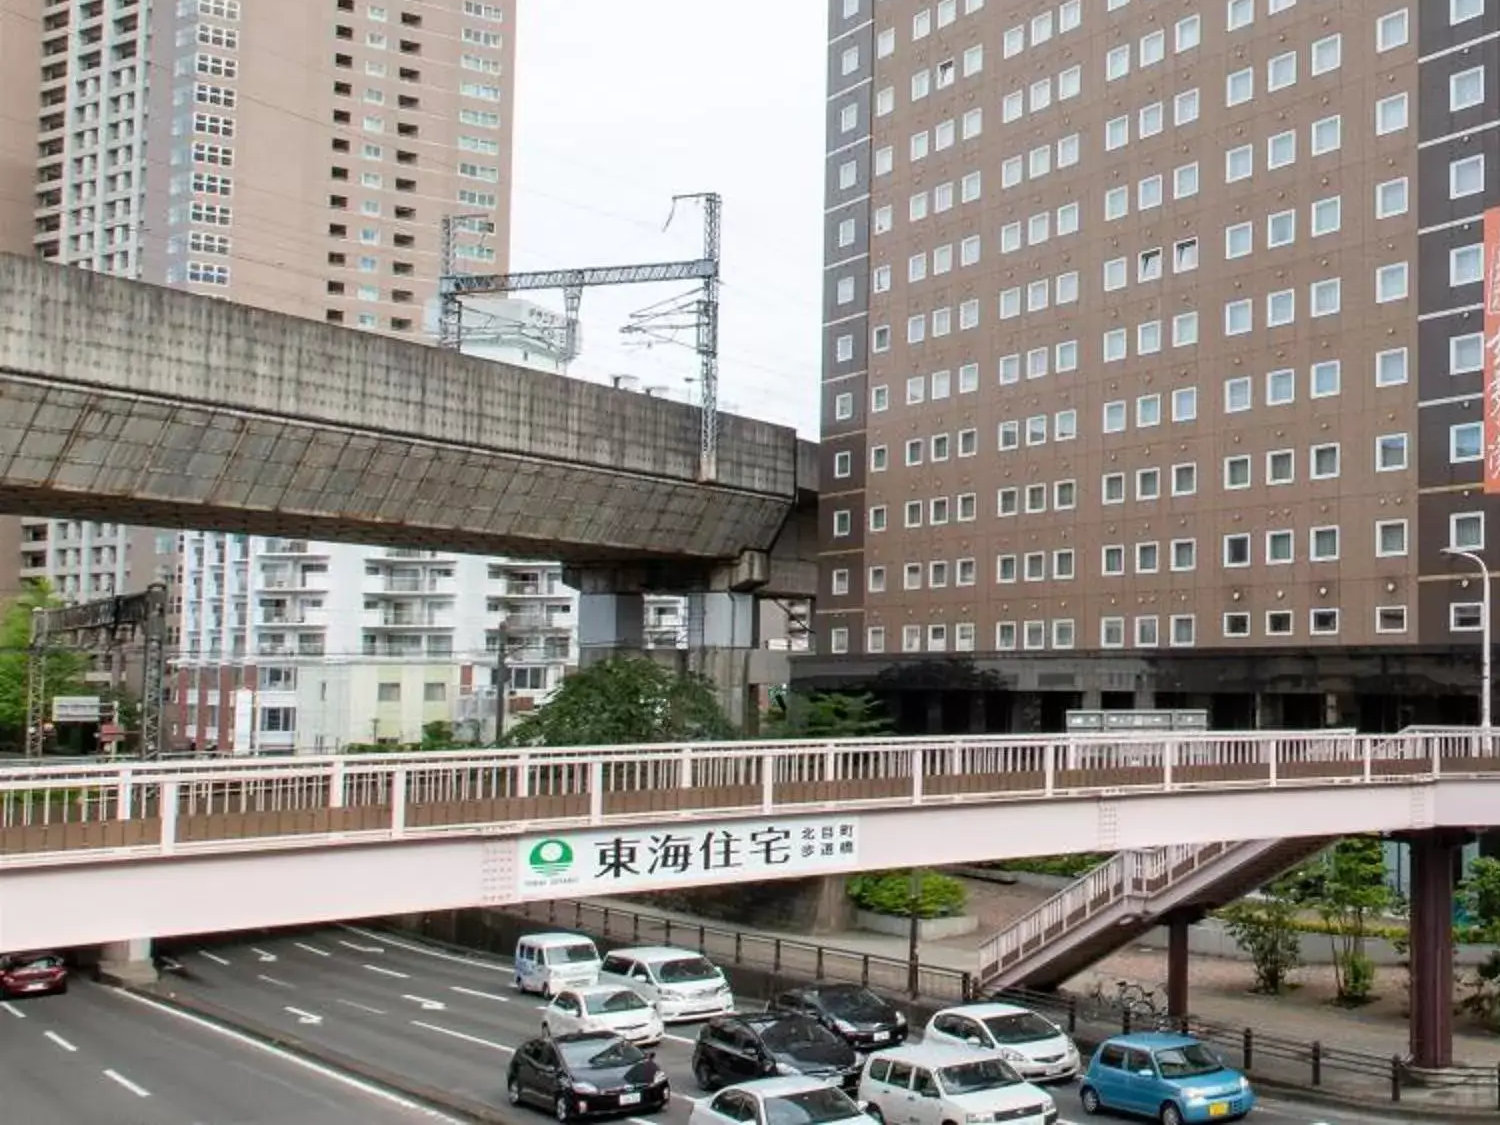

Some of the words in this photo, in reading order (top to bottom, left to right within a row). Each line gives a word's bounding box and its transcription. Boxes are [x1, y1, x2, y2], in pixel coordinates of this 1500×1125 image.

[801, 824, 854, 840] 北目町
[593, 826, 791, 879] 東海住宅
